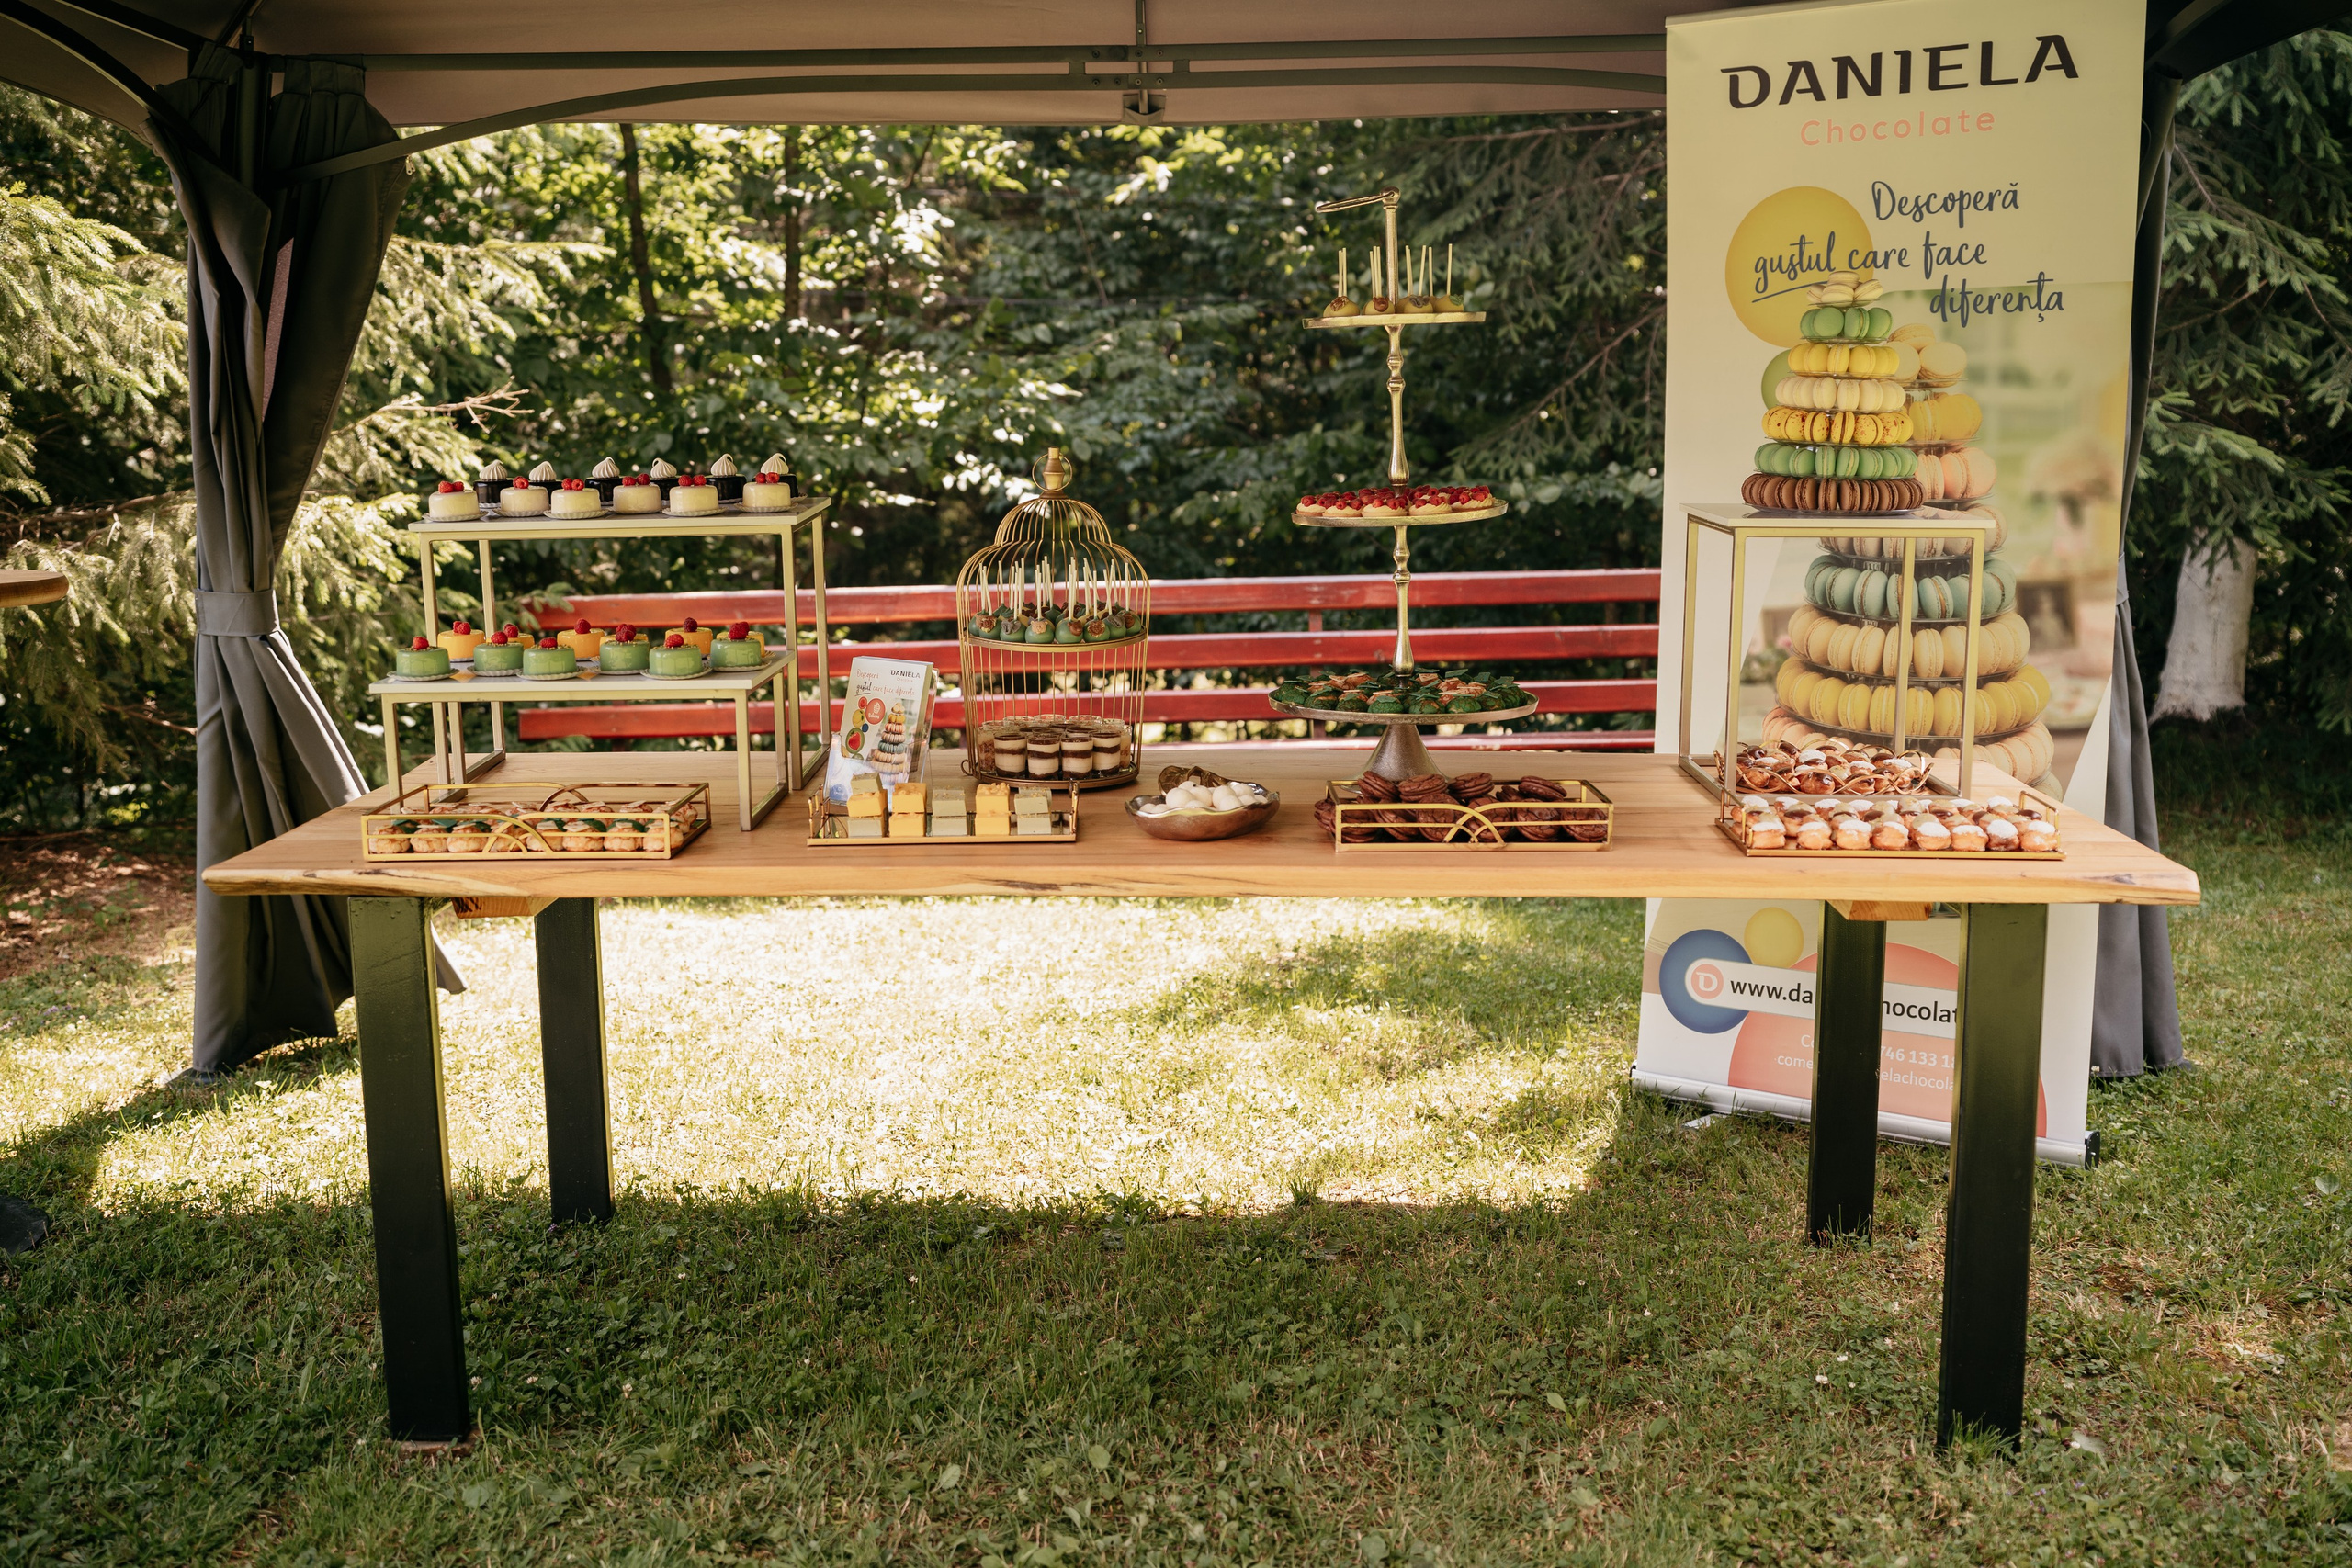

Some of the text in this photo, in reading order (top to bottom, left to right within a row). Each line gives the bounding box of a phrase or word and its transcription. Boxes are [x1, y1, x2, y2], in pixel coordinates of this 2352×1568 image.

[1720, 34, 2079, 109] DANIELA
[1800, 110, 1996, 146] Chocolate
[1871, 180, 2020, 229] Descoperă
[1754, 231, 1988, 294] gustul care face
[890, 670, 921, 679] DANIELA
[1695, 971, 1718, 992] D
[1909, 1050, 1938, 1066] 133
